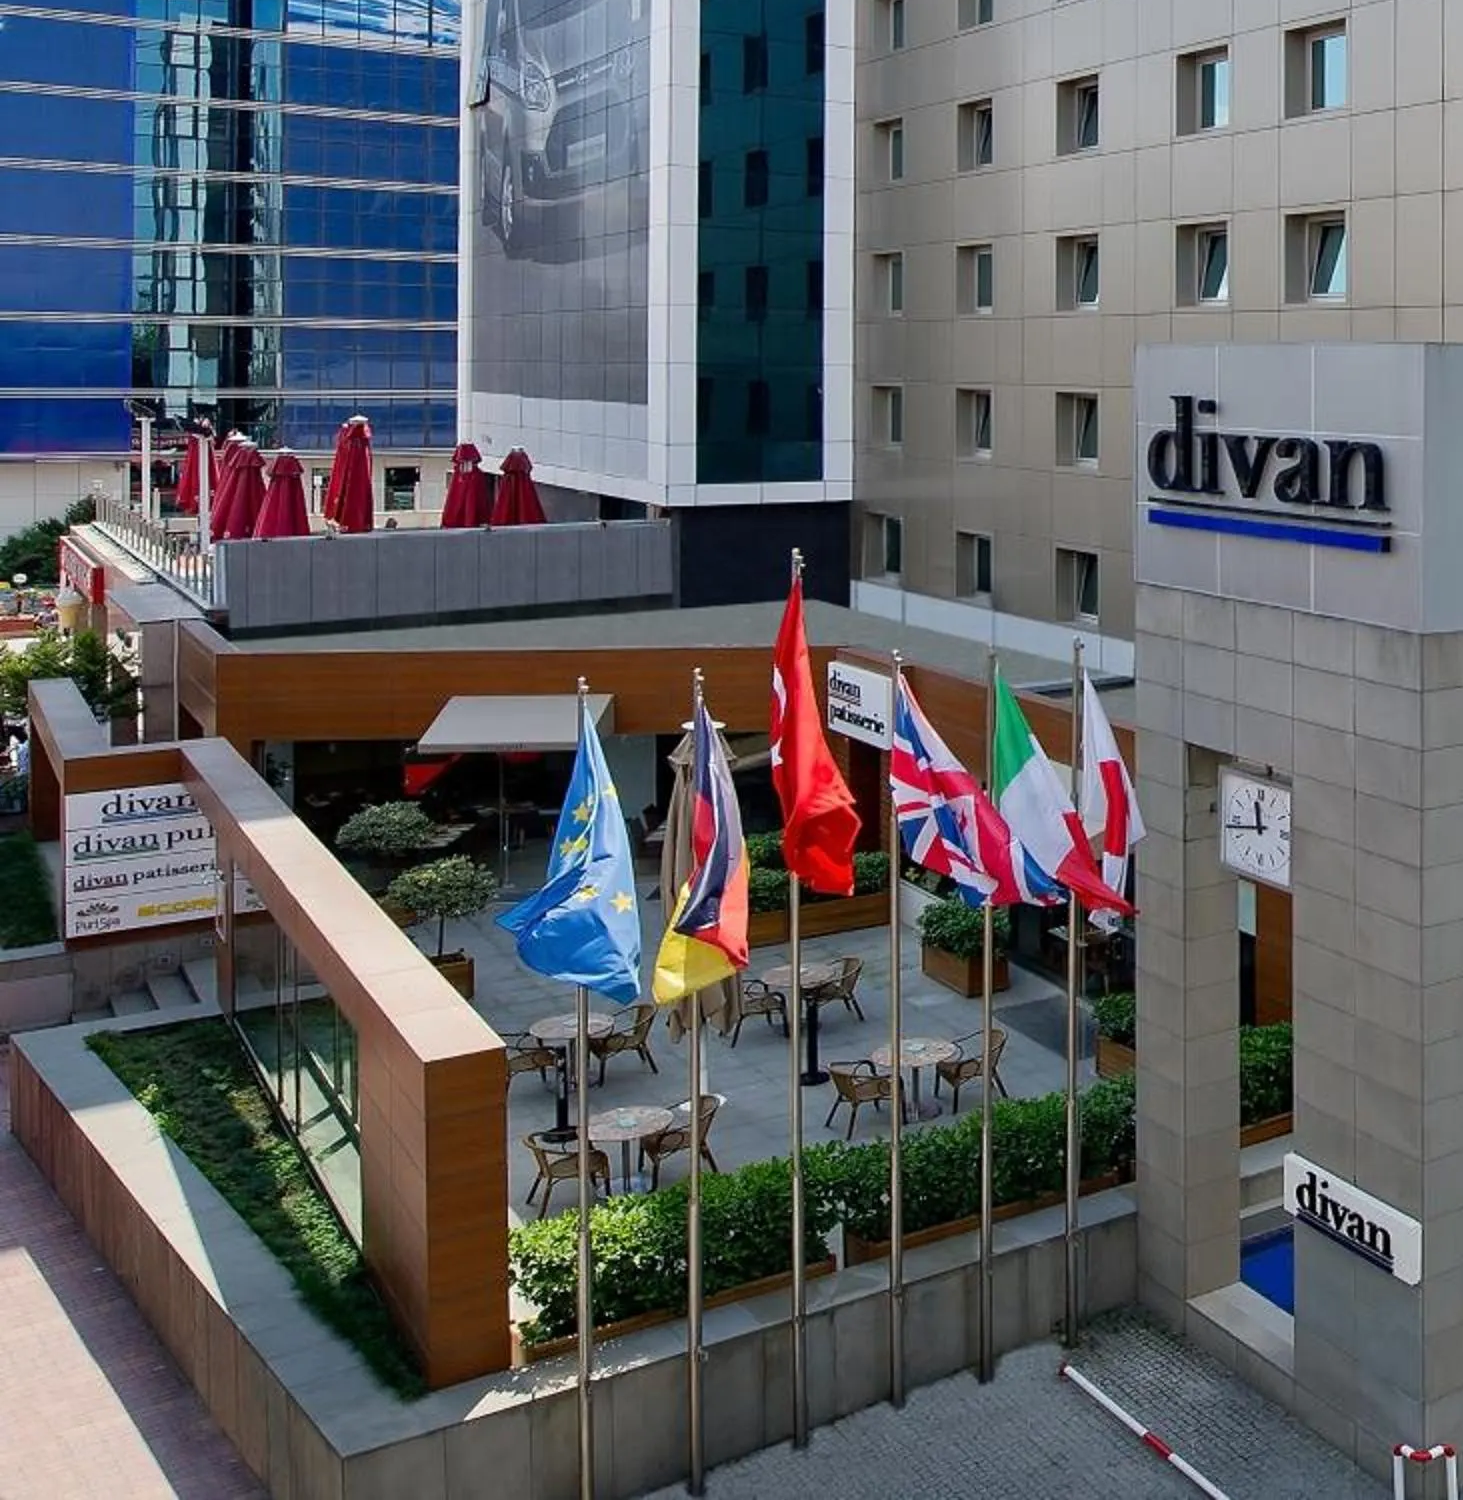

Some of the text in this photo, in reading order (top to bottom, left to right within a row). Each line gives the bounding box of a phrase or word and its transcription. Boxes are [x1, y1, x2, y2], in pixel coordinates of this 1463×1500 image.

[1148, 395, 1391, 512] divan
[829, 669, 861, 698] divan
[829, 704, 885, 736] patisserie
[73, 833, 158, 854] divan
[73, 872, 128, 889] divan
[1296, 1171, 1394, 1260] divan
